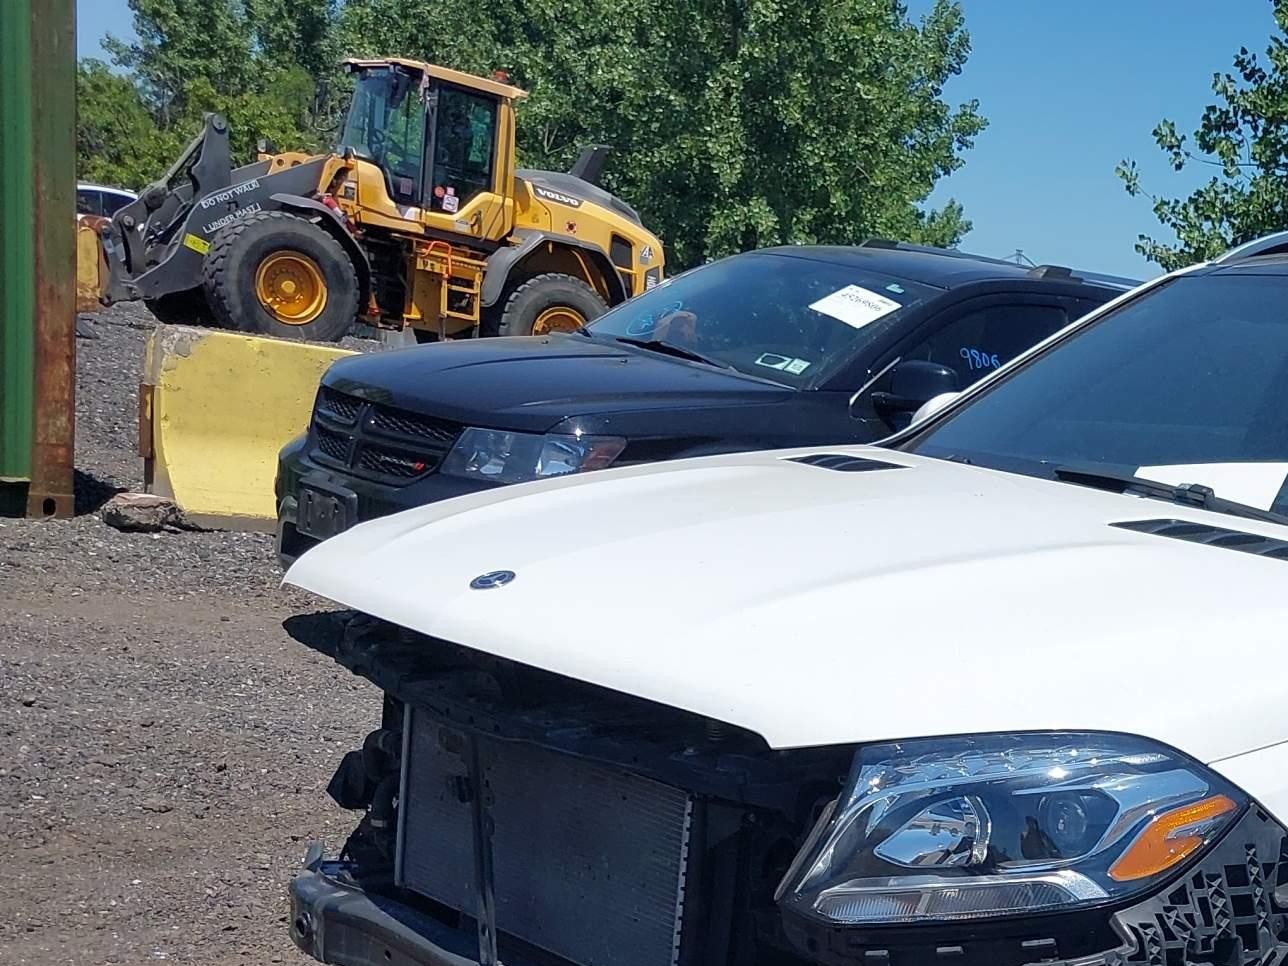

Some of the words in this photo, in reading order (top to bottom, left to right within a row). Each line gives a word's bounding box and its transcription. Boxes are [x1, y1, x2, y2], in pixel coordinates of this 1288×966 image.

[200, 199, 216, 209] DO
[216, 190, 234, 203] NOT
[234, 180, 258, 195] WALK
[536, 188, 579, 206] VOLVO
[208, 214, 236, 231] UNDER
[236, 204, 256, 218] MAST
[959, 347, 1001, 370] 9806
